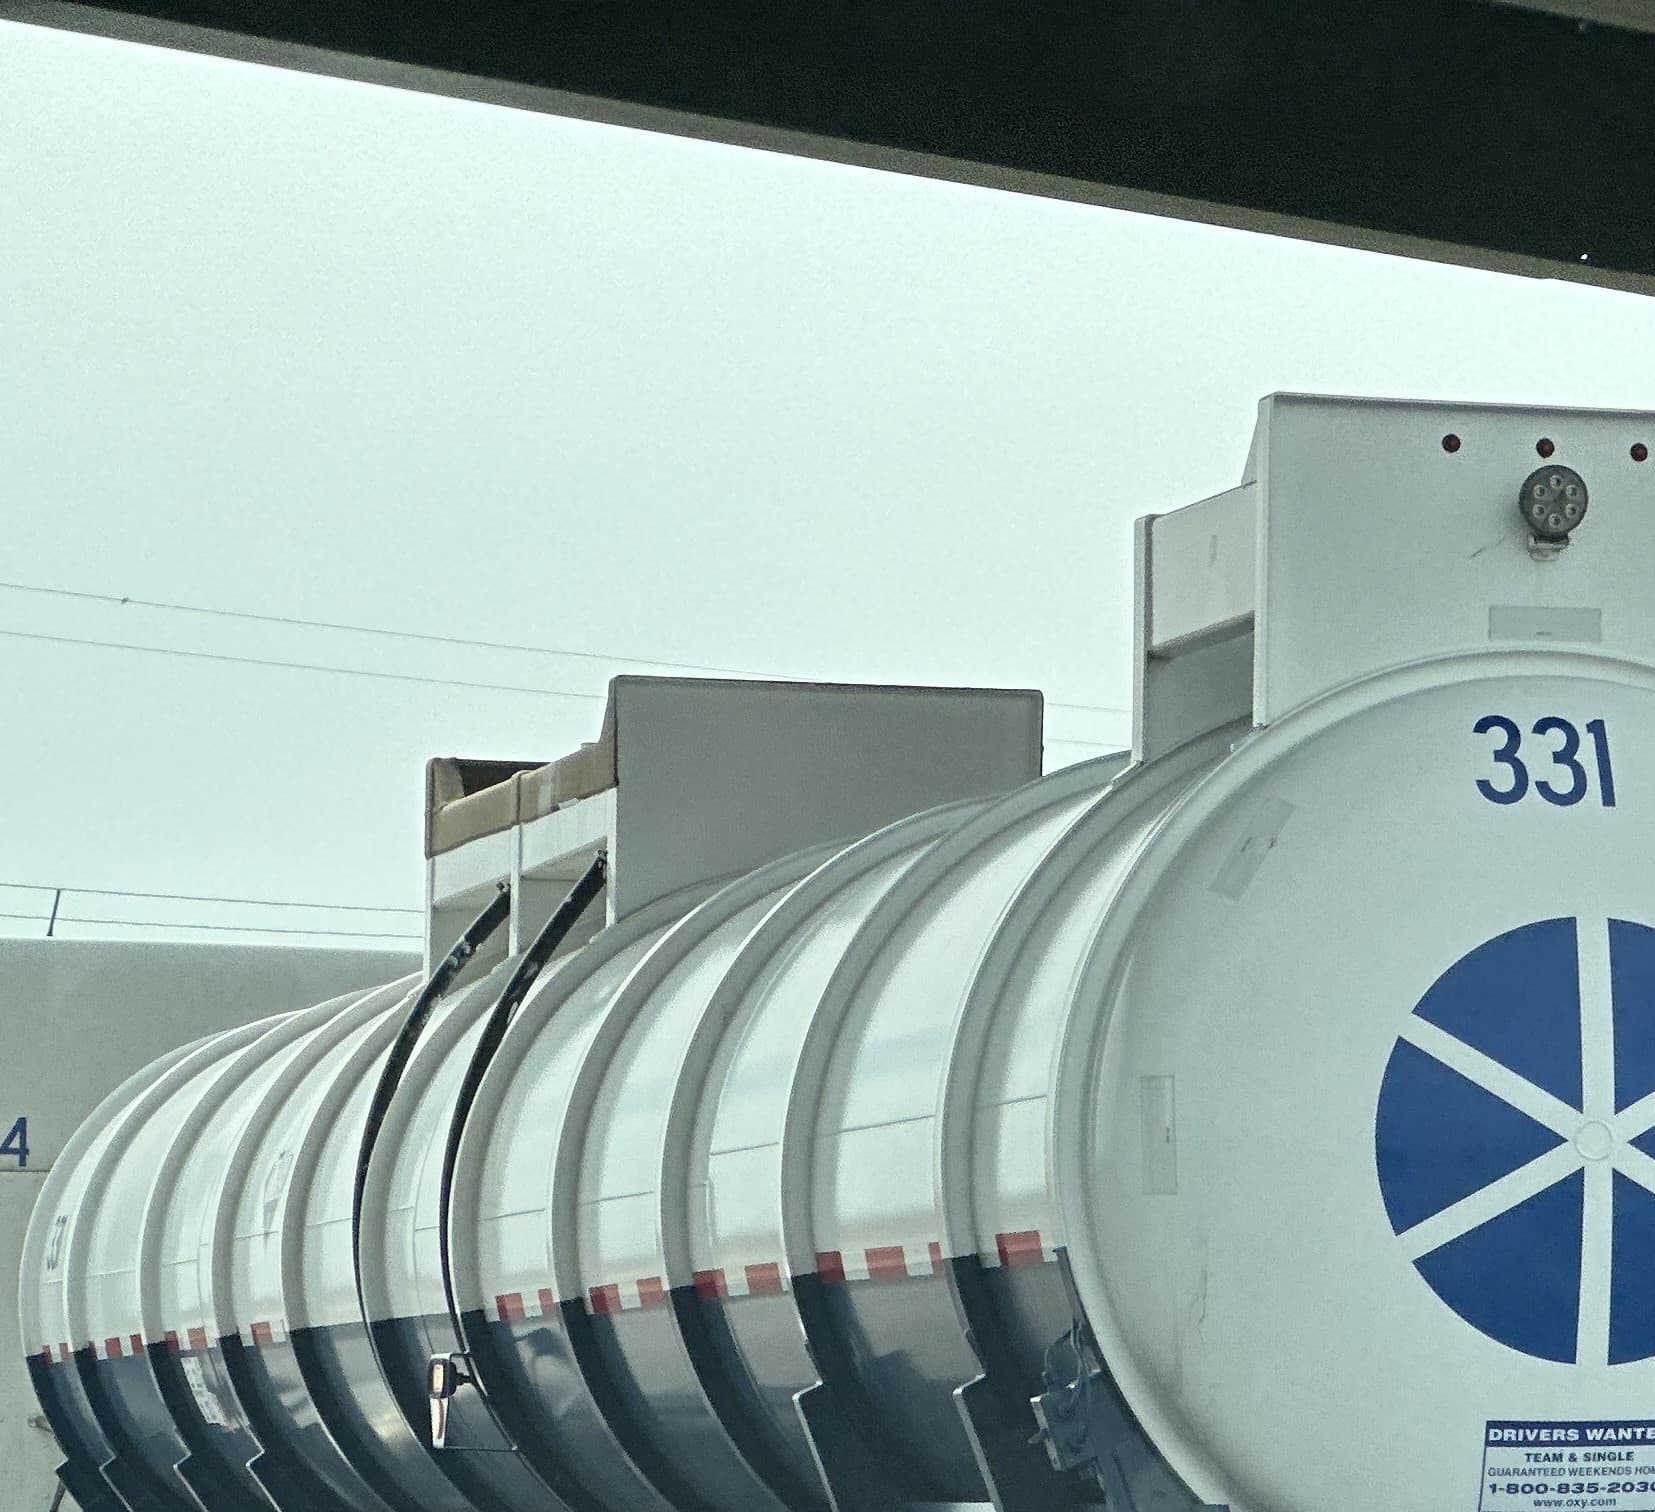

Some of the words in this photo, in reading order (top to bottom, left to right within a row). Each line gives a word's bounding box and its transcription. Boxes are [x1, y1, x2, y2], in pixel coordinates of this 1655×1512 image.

[1472, 714, 1616, 807] 331
[1488, 1428, 1580, 1441] DRIVERS
[1524, 1452, 1564, 1463] TEAM
[1568, 1452, 1578, 1463] &
[1583, 1451, 1635, 1462] SINGLE
[1487, 1467, 1566, 1477] GUARANTEED
[1567, 1466, 1633, 1477] WEEKENDS
[1533, 1498, 1617, 1509] www.oxy.com
